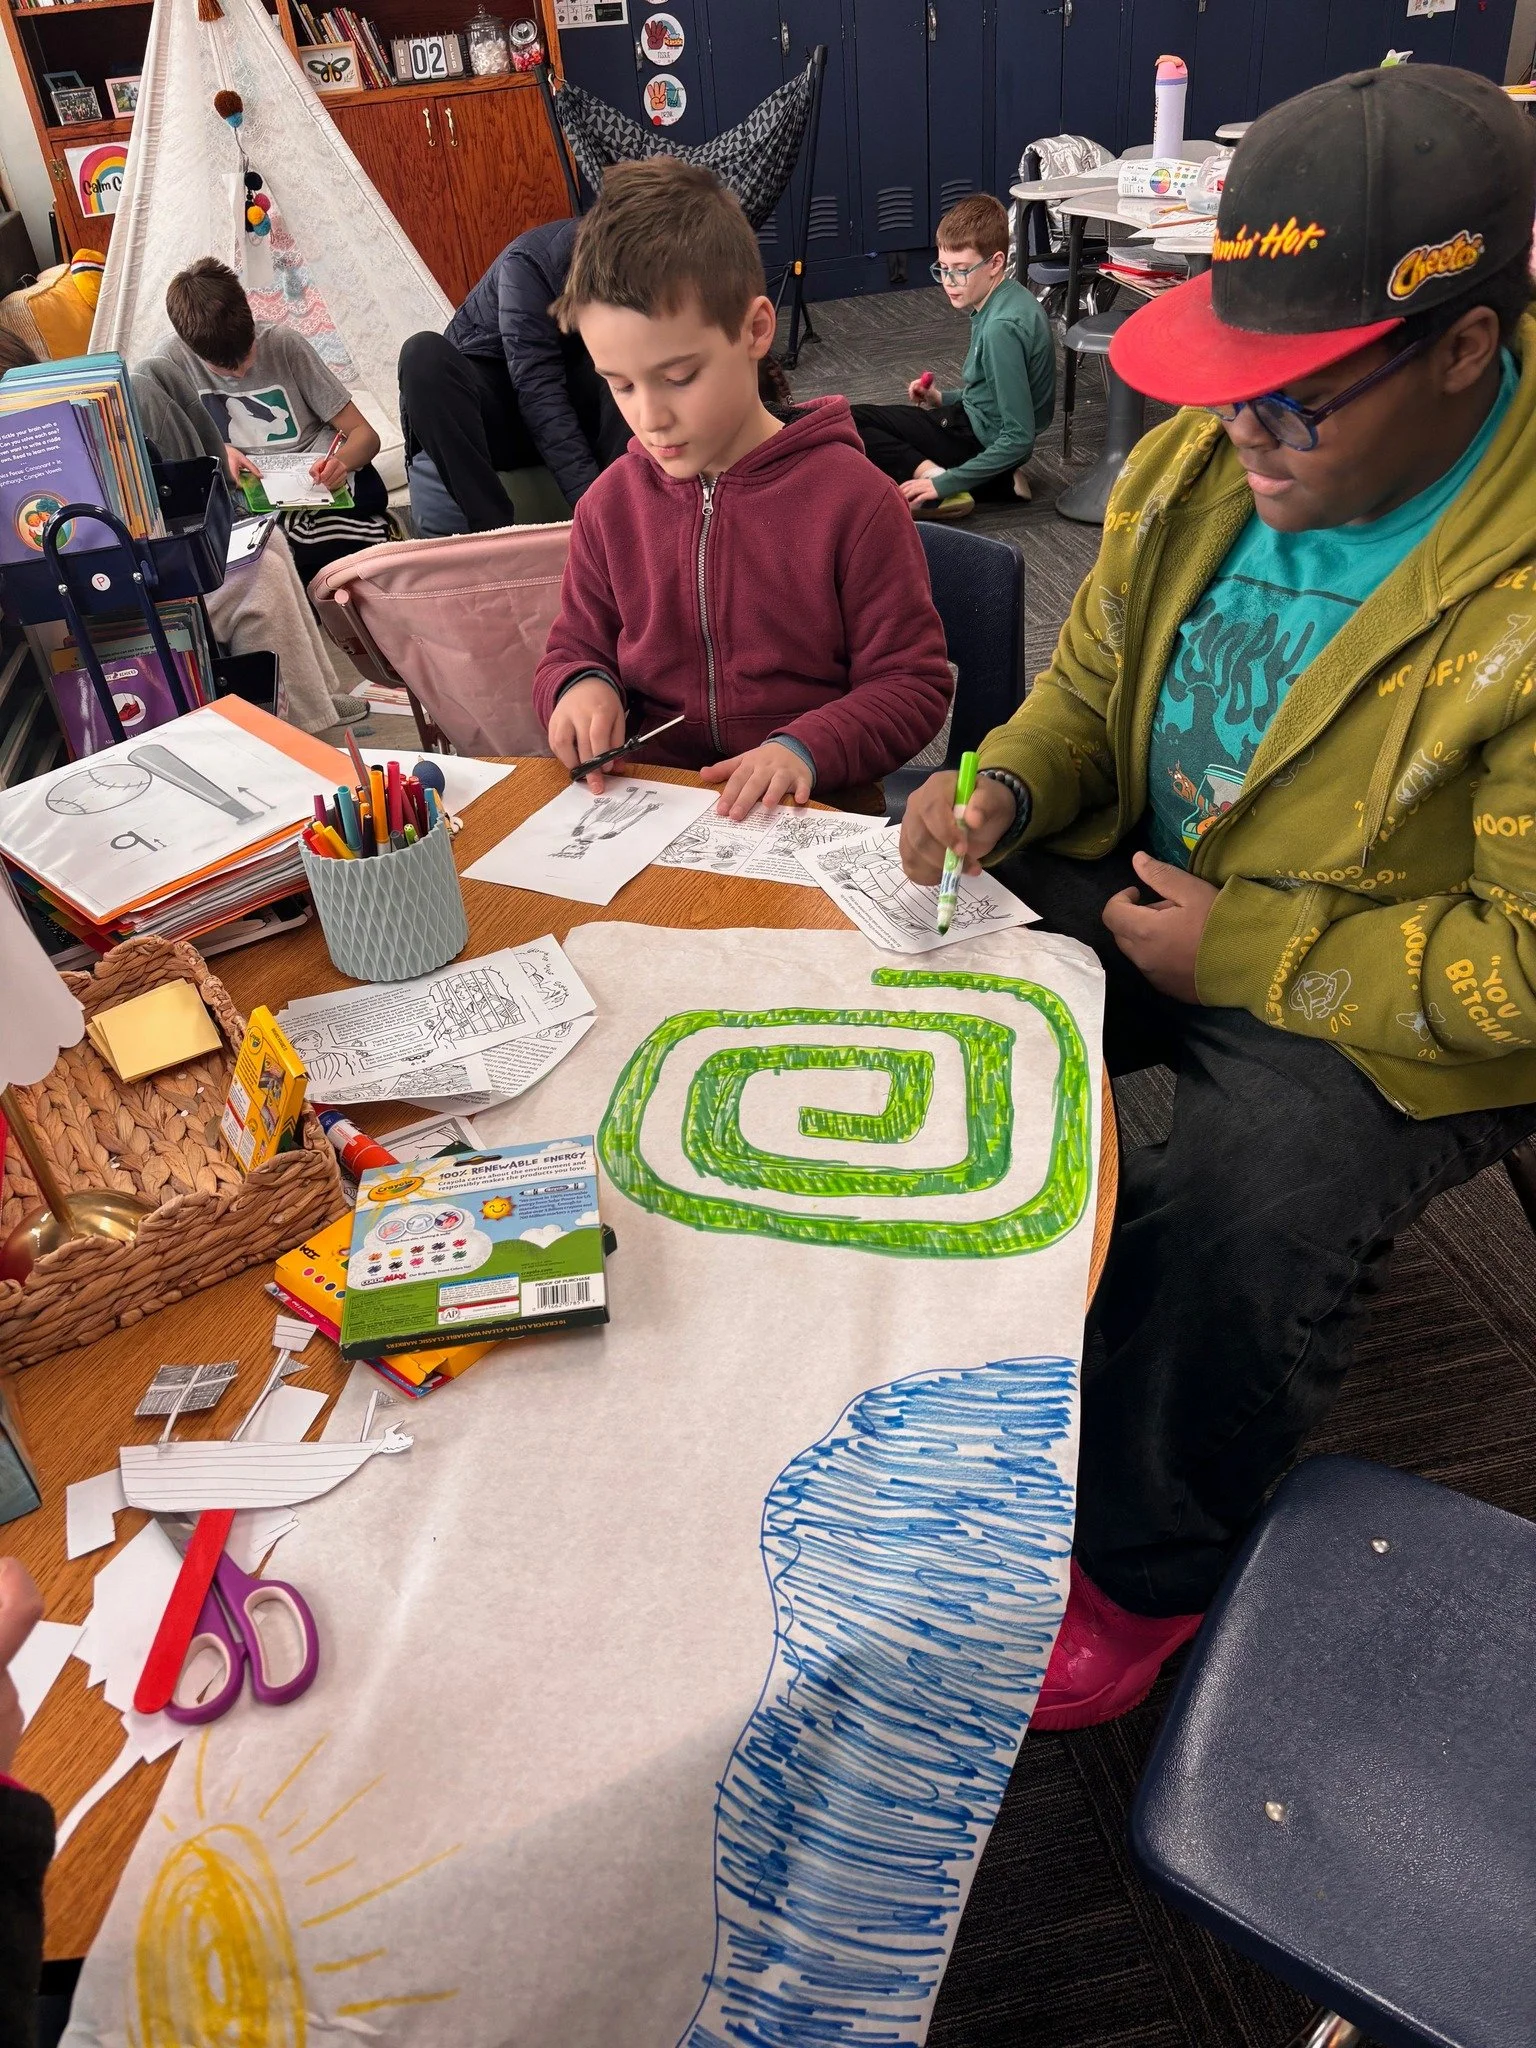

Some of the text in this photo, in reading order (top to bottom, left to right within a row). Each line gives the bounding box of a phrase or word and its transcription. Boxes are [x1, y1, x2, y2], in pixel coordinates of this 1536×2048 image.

[412, 43, 445, 75] 02
[449, 43, 457, 69] FEB
[83, 176, 122, 196] Calm C
[1258, 216, 1326, 260] Hot
[1387, 230, 1485, 300] Cheetos
[1104, 510, 1141, 533] OF!
[439, 1151, 586, 1180] 100% RENEWABLE ENERGY
[438, 1177, 466, 1187] Crayola
[467, 1174, 486, 1182] cares
[487, 1171, 510, 1179] about
[524, 1164, 571, 1173] environment
[438, 1181, 480, 1191] responsibly
[520, 1170, 553, 1180] products
[554, 1168, 568, 1176] you
[377, 1179, 415, 1194] Crayola
[562, 1276, 591, 1284] PURCHASE
[445, 1308, 458, 1319] AP
[480, 1324, 526, 1335] ULTRA-CLEAN
[527, 1319, 558, 1329] CRAYOLA
[418, 1335, 444, 1344] CLASSIC
[444, 1330, 480, 1340] WASHABLE
[384, 1339, 417, 1349] MARKERS
